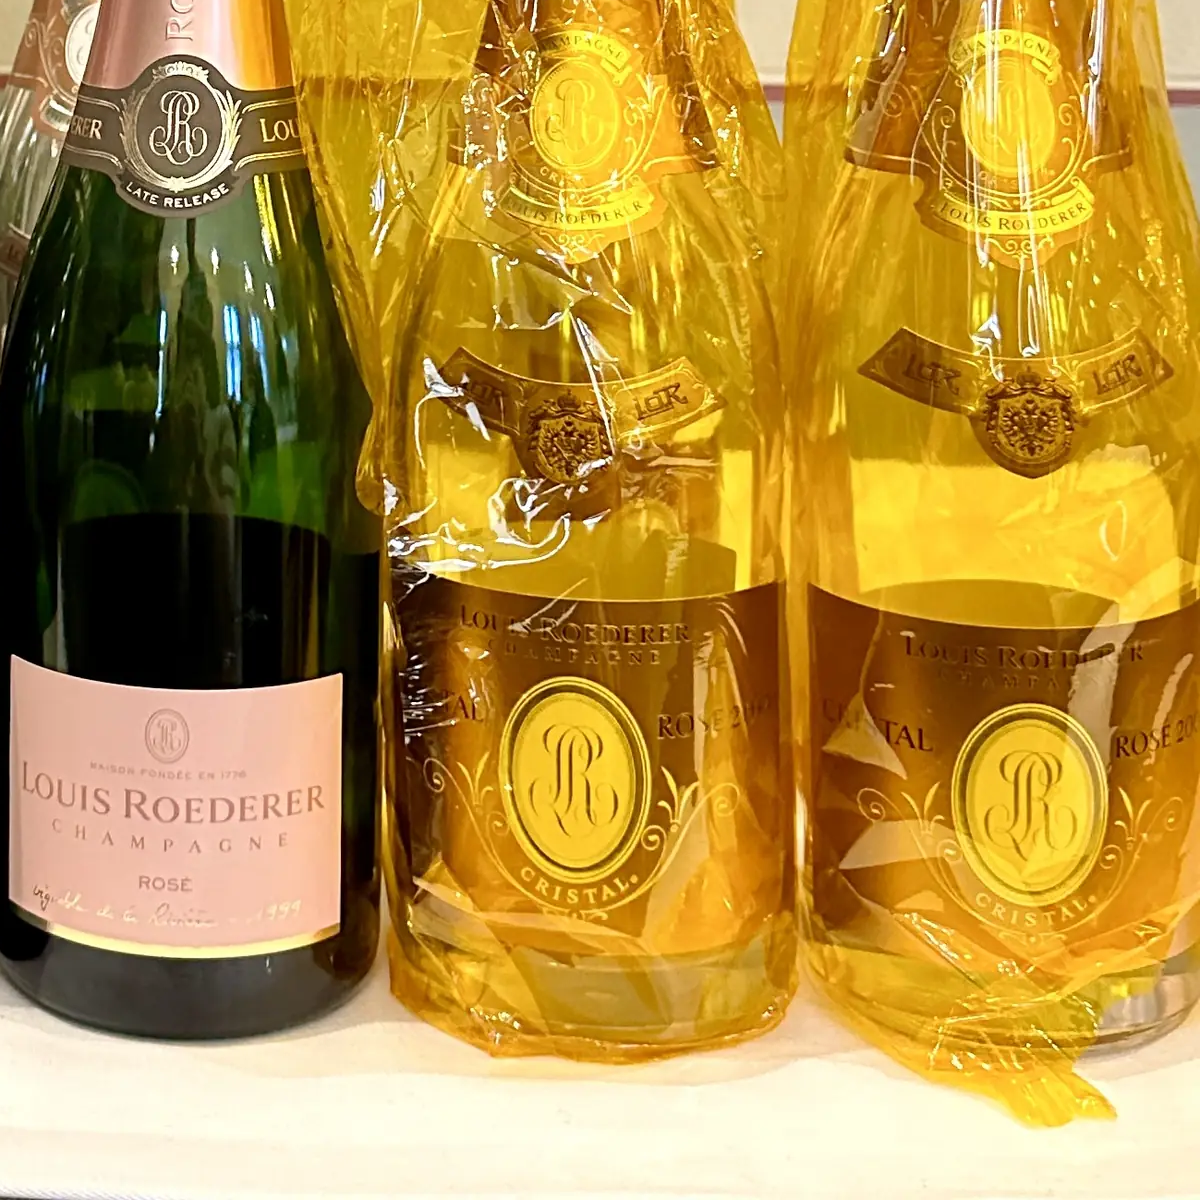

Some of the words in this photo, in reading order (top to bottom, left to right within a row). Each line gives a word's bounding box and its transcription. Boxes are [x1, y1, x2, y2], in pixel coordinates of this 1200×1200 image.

[542, 33, 626, 62] AMPAGNE
[260, 117, 299, 143] LOU
[126, 180, 160, 205] LATE
[163, 182, 230, 209] RELEASE
[540, 616, 692, 647] ROEDERER
[904, 634, 989, 668] LOUIS
[998, 640, 1144, 670] ROEDR
[940, 669, 1062, 691] CHAMPA
[89, 761, 136, 776] MAISON
[140, 766, 194, 781] FONDÉE
[198, 771, 216, 781] EN
[220, 769, 247, 780] 1776
[21, 760, 111, 816] LOUIS
[124, 784, 326, 825] ROEDERER
[51, 818, 290, 855] CHAMPAGNE
[138, 875, 194, 893] ROSÉ
